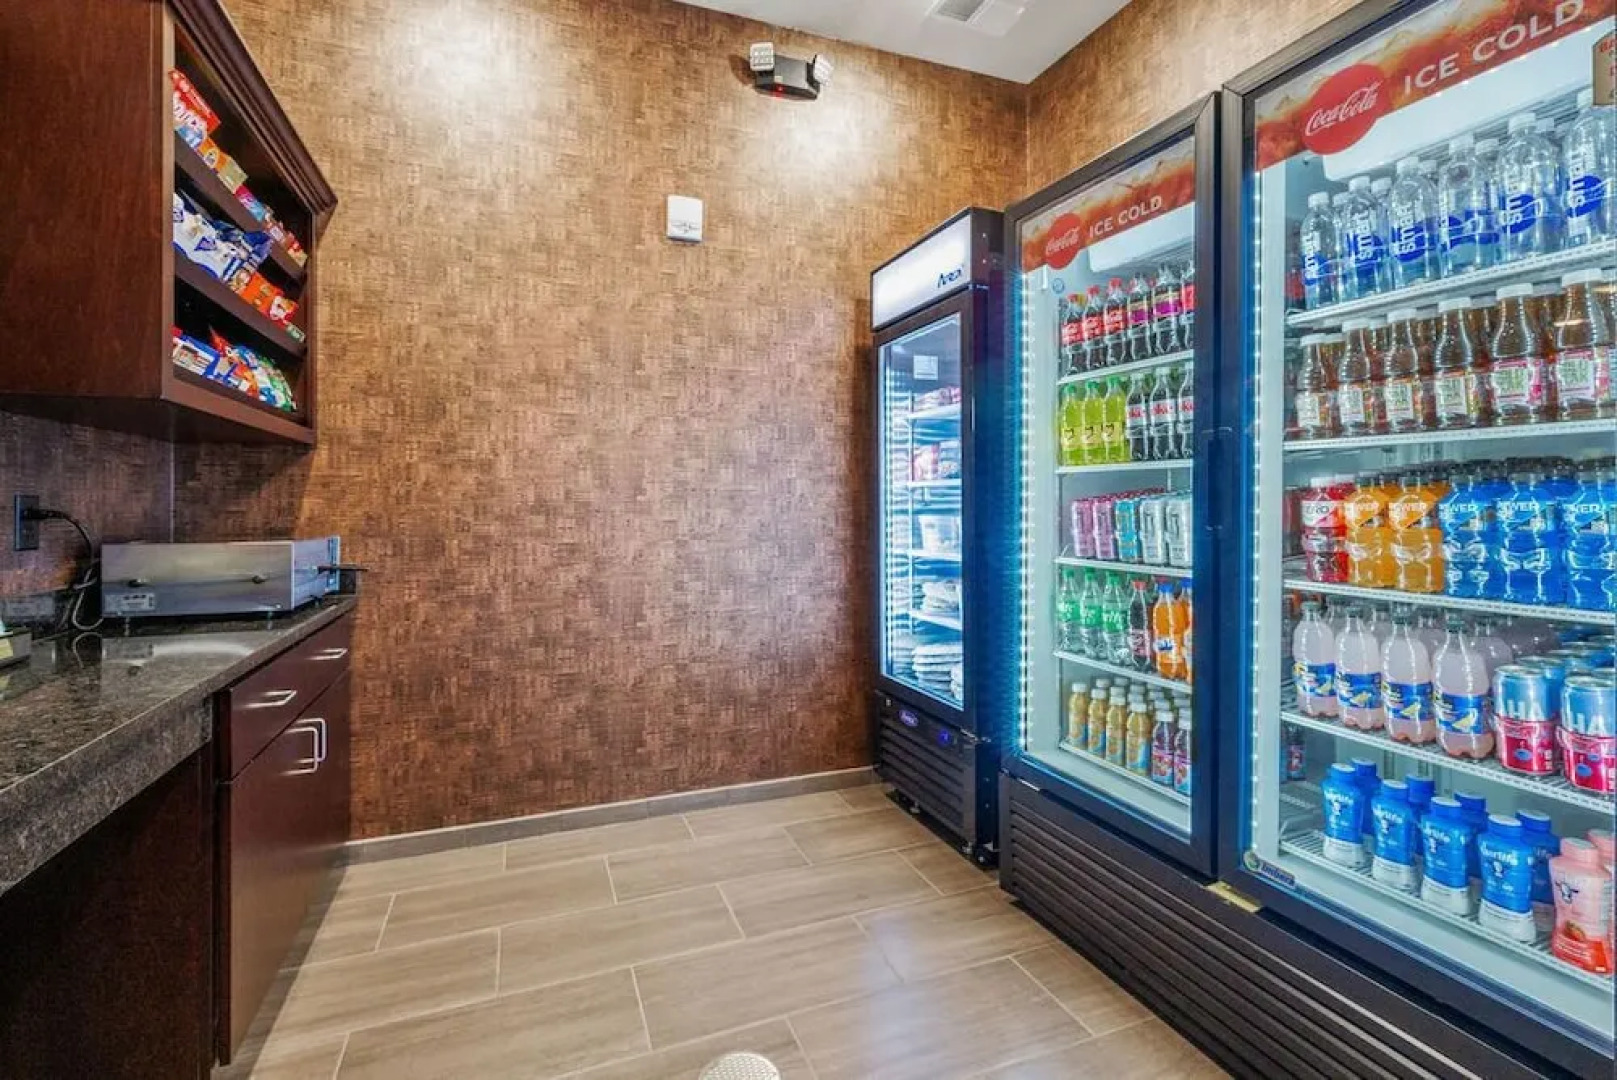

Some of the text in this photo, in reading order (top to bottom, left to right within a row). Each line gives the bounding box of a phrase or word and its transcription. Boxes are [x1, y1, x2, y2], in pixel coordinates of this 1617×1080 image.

[1403, 1, 1583, 95] ICE COLD
[1088, 195, 1163, 239] ICE COLD
